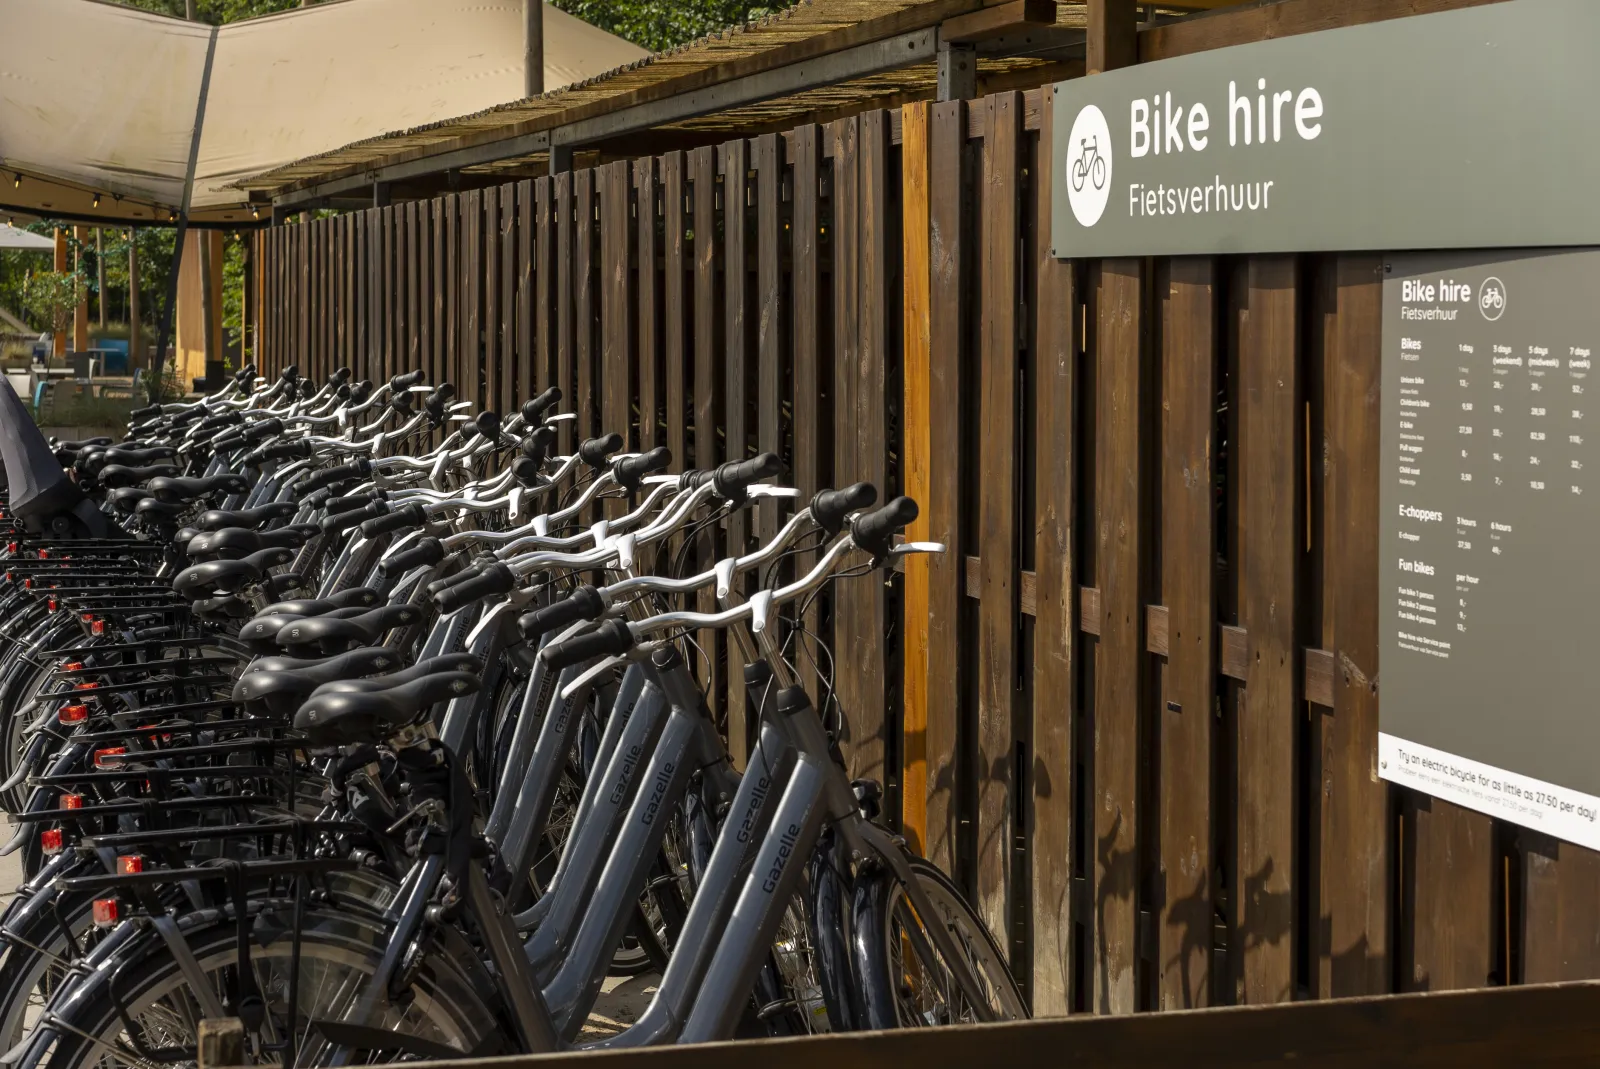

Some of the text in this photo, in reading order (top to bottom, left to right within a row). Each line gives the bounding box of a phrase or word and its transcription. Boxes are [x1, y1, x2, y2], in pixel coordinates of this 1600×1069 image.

[1130, 77, 1323, 158] Bike hire
[1129, 174, 1274, 217] Fietsverhuur
[1403, 279, 1472, 302] Bike hire
[1402, 306, 1459, 320] Fietsverhuur
[1401, 338, 1422, 349] Bikes
[1462, 344, 1474, 353] day
[1497, 345, 1512, 354] days
[1529, 346, 1549, 356] 5 days
[1570, 347, 1591, 357] 7 days
[1399, 505, 1443, 522] E-choppers
[1457, 517, 1476, 527] 3 hours
[1491, 522, 1512, 532] 6 hours
[1398, 558, 1435, 576] Fun bikes
[1456, 574, 1480, 584] per hour
[453, 616, 470, 652] azelle
[609, 745, 642, 804] Gazelle
[641, 762, 674, 826] Gazelle
[1398, 749, 1410, 764] Try
[1411, 754, 1421, 765] an
[1422, 759, 1449, 776] electric
[1450, 765, 1476, 783] bicycle
[1478, 773, 1491, 787] for
[1492, 780, 1502, 792] as
[1503, 782, 1522, 797] little
[1524, 790, 1534, 801] as
[1559, 801, 1576, 812] per
[1577, 806, 1597, 822] day!
[736, 777, 771, 843] Gazelle
[762, 823, 800, 894] Gazelle
